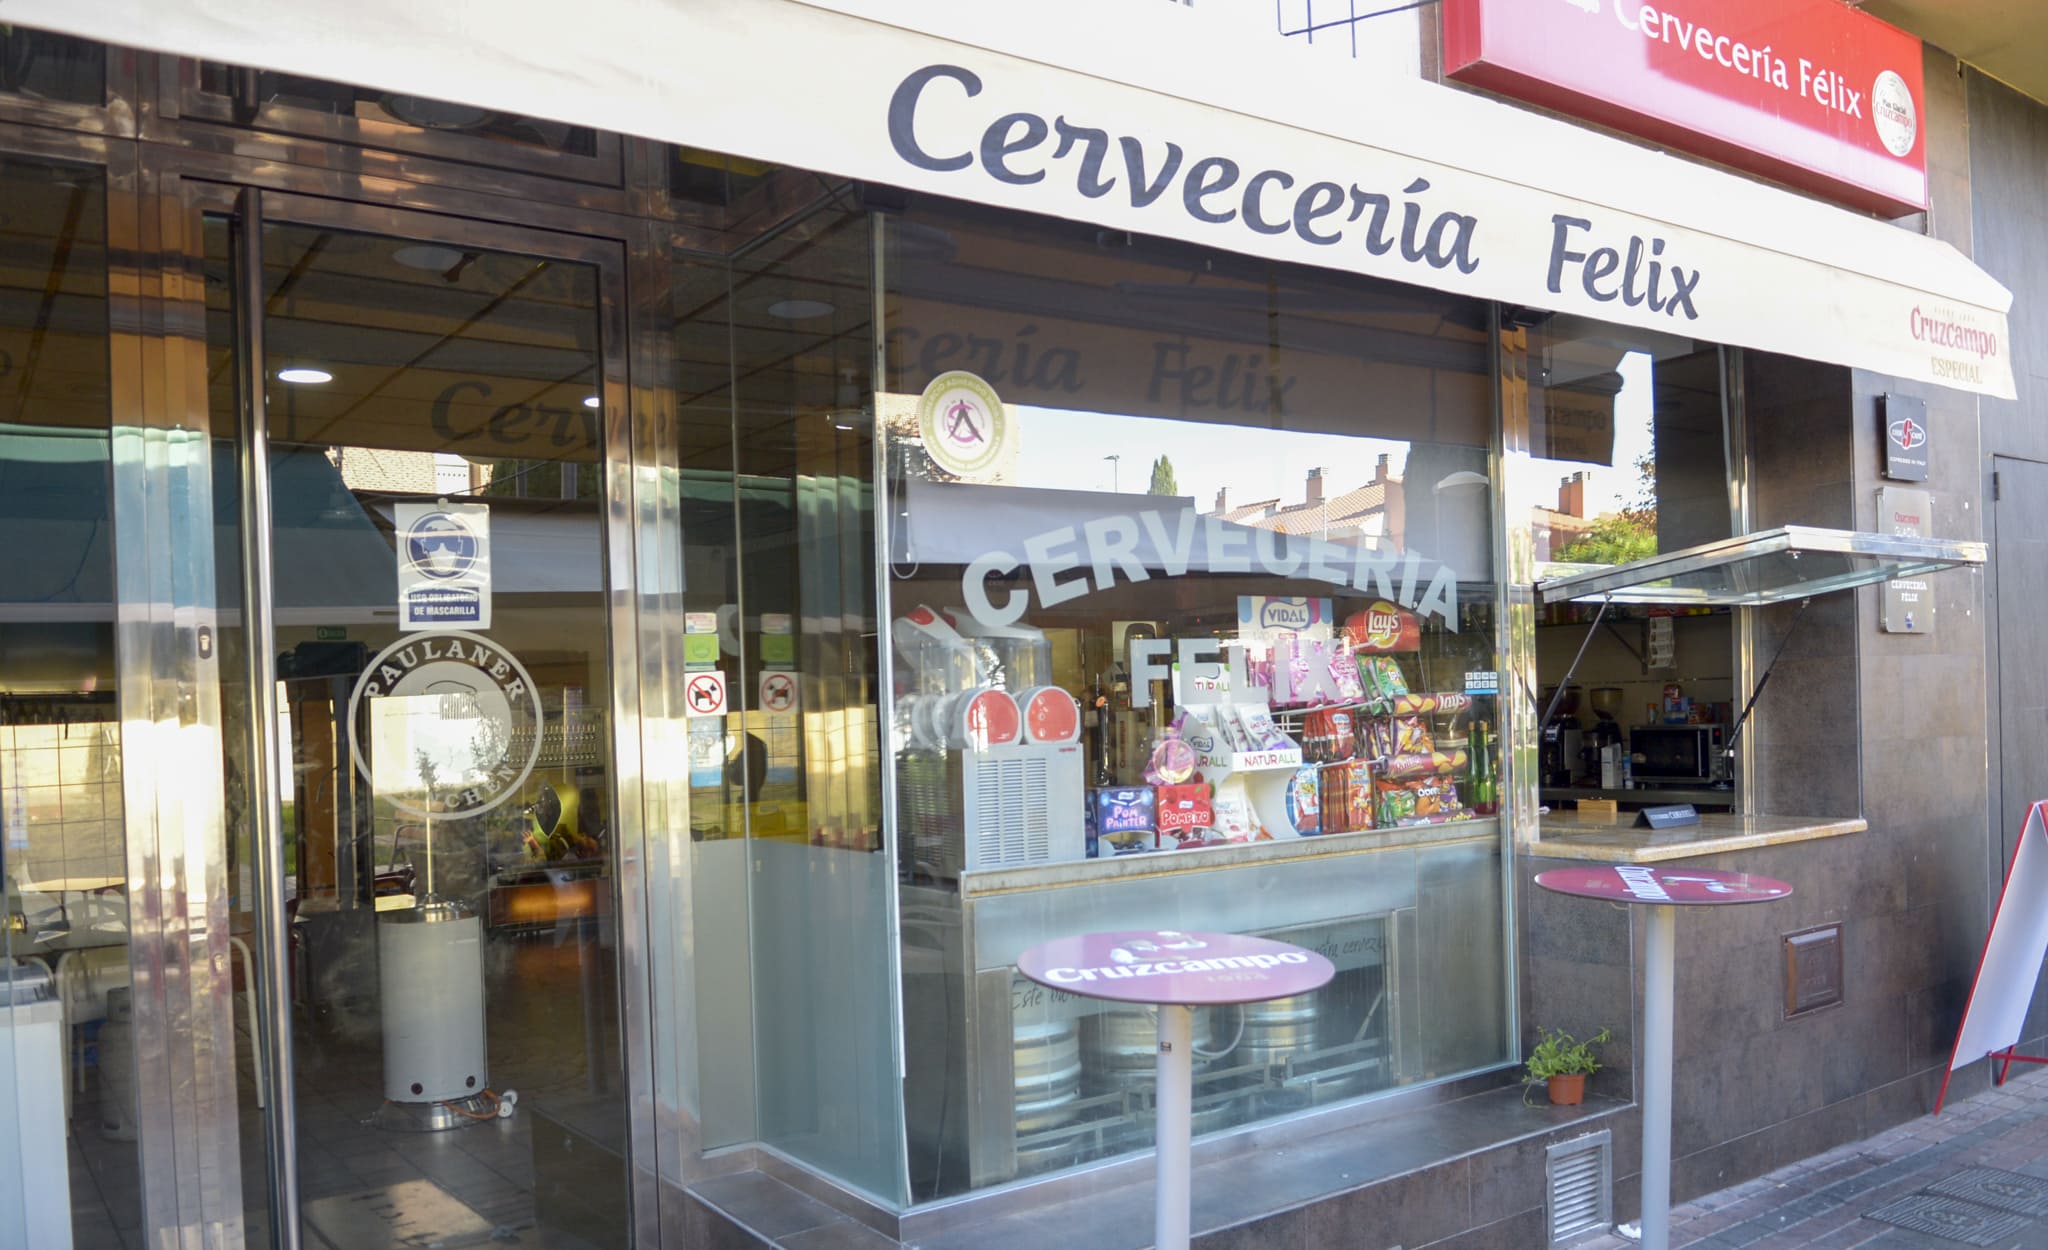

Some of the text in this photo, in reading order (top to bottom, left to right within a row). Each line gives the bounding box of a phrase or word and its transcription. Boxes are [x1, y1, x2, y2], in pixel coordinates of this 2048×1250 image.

[1613, 0, 1862, 118] Cervecería Félix
[886, 64, 1700, 321] Cervecería Felix
[1910, 305, 1997, 360] Cruzcampo
[1931, 356, 1984, 384] ESPECIAL
[414, 606, 476, 616] DE MASCARILLA
[1268, 608, 1306, 623] VIDAL
[1367, 611, 1399, 639] Lay's
[364, 640, 526, 702] PAULANER
[1244, 752, 1297, 767] NATURALL
[1045, 951, 1309, 983] Cruzcampo
